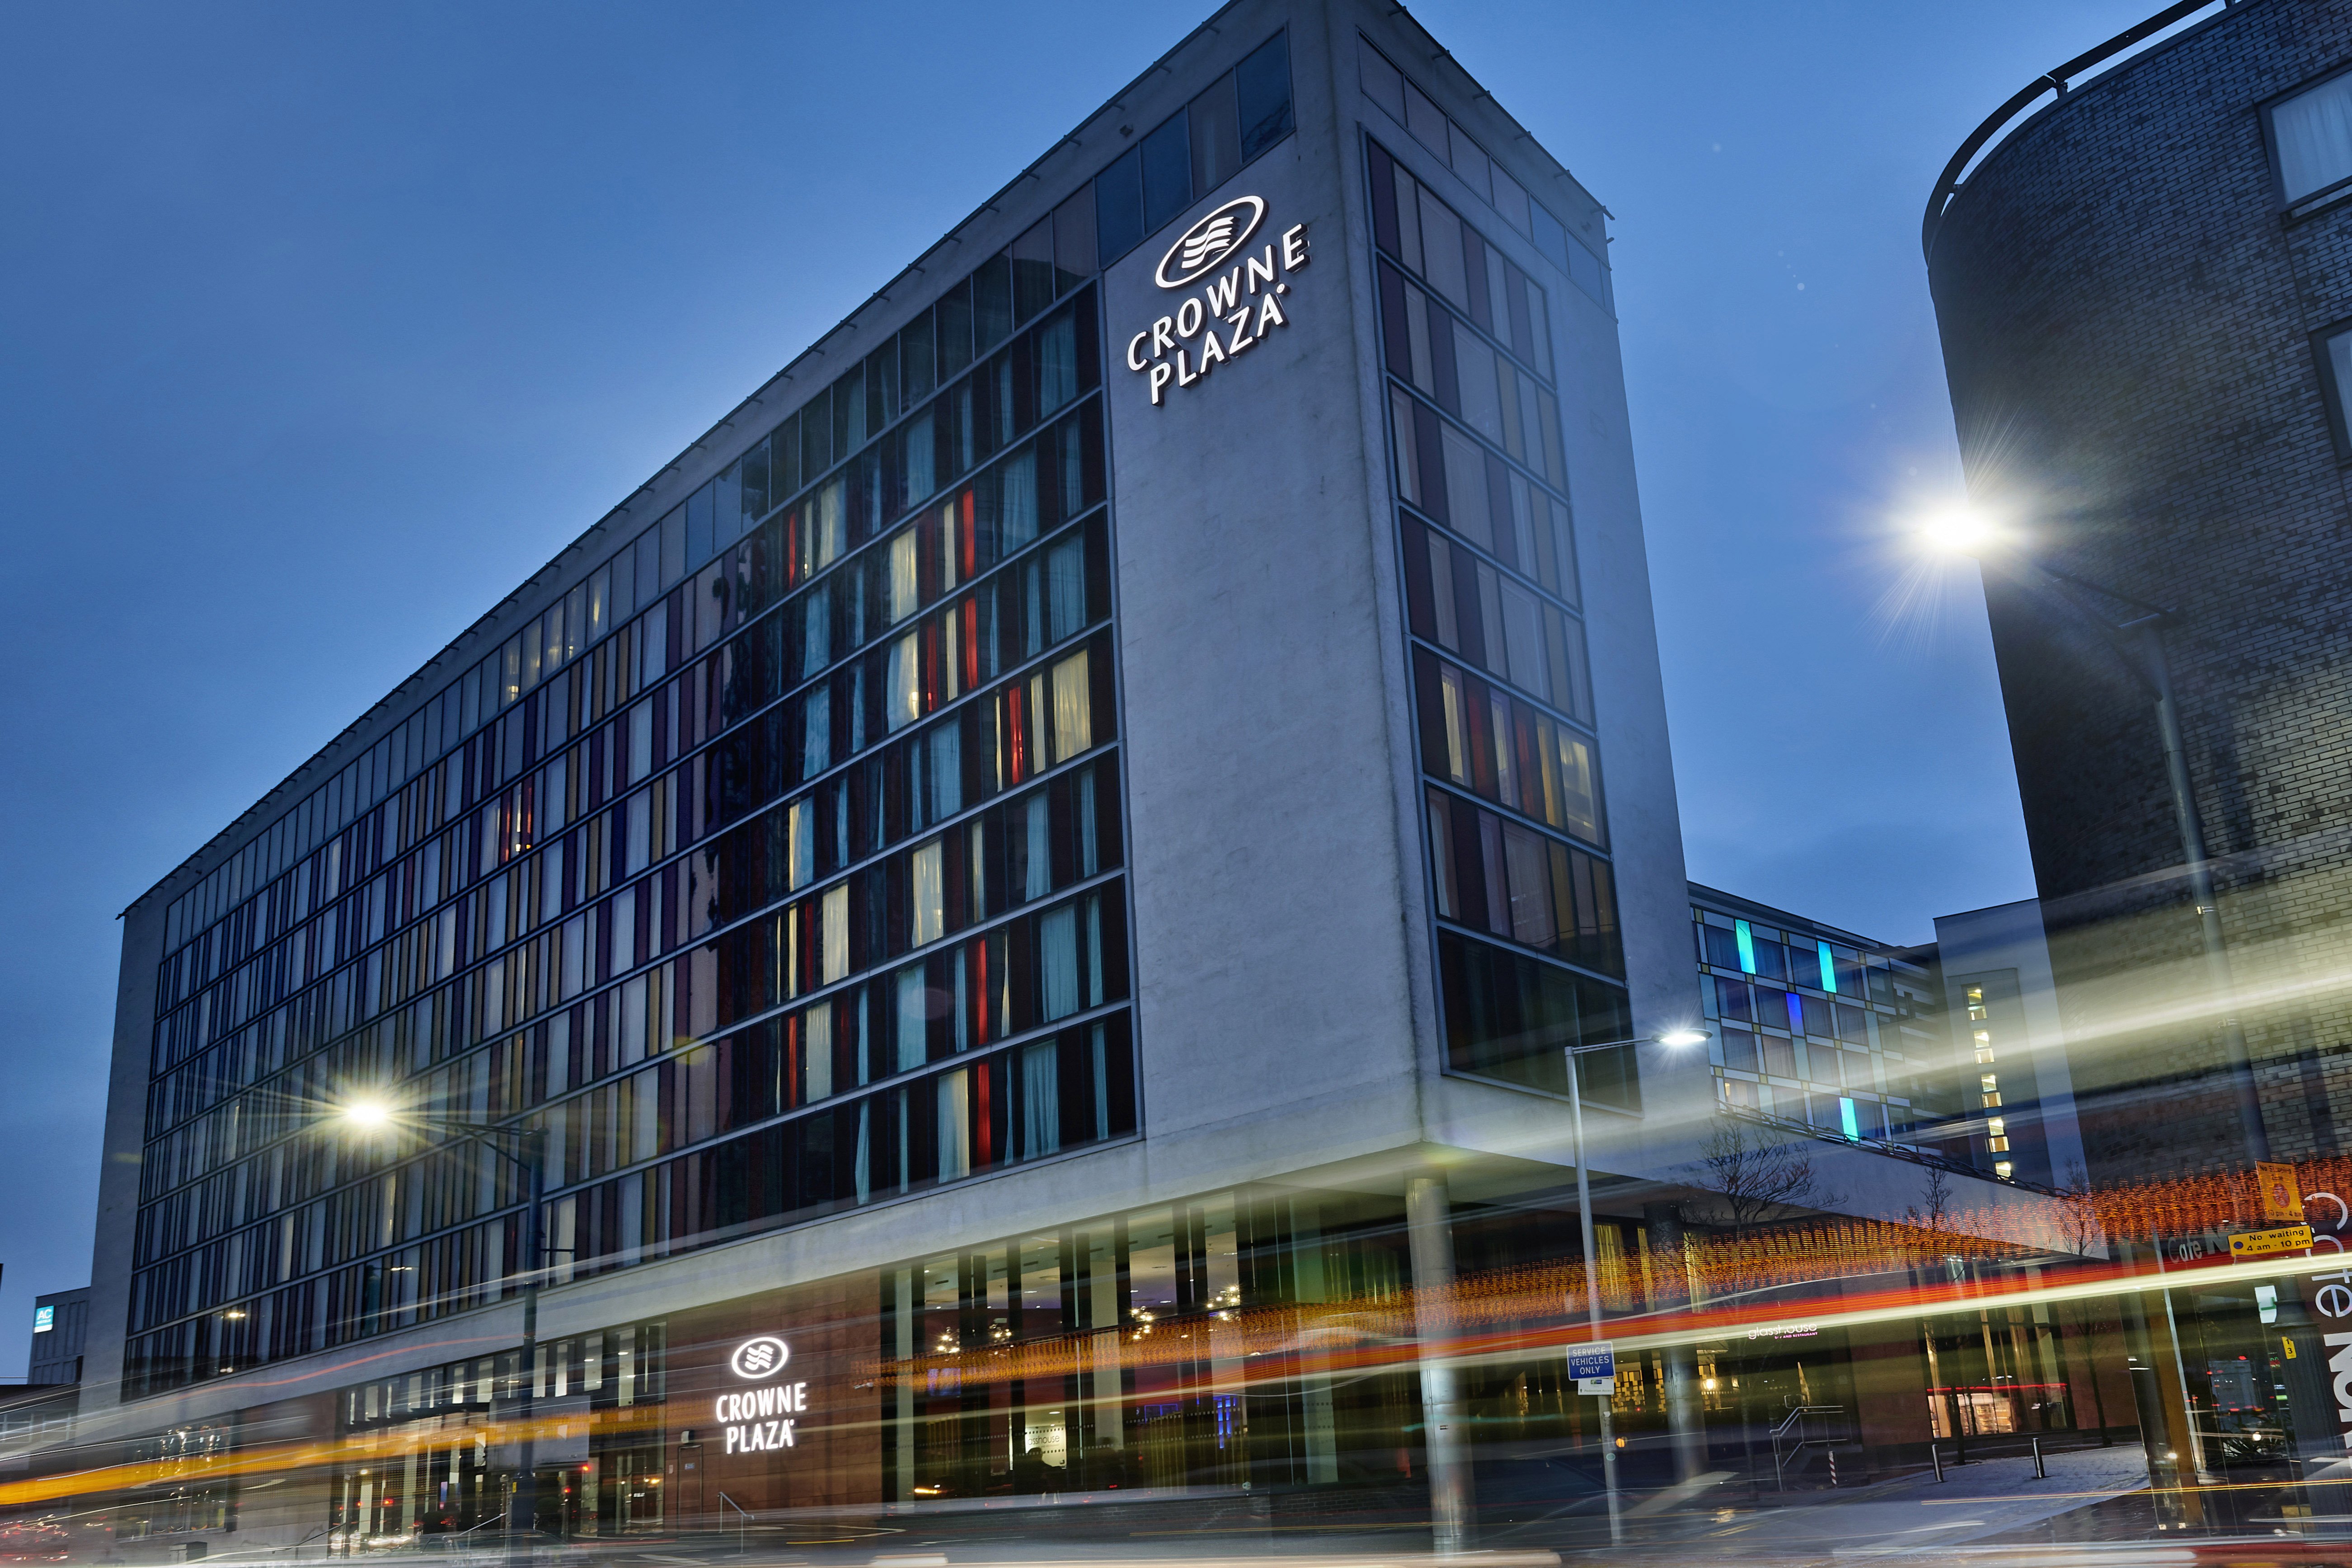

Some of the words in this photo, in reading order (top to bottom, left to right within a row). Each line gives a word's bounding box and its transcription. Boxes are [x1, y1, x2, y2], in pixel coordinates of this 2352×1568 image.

[1127, 223, 1309, 371] CROWNE
[2268, 1230, 2304, 1239] waiting
[37, 1309, 52, 1320] AC
[1573, 1347, 1606, 1357] SERVICE
[1571, 1356, 1610, 1366] VEHICLES
[1580, 1366, 1601, 1375] ONLY
[716, 1382, 807, 1422] CROWNE
